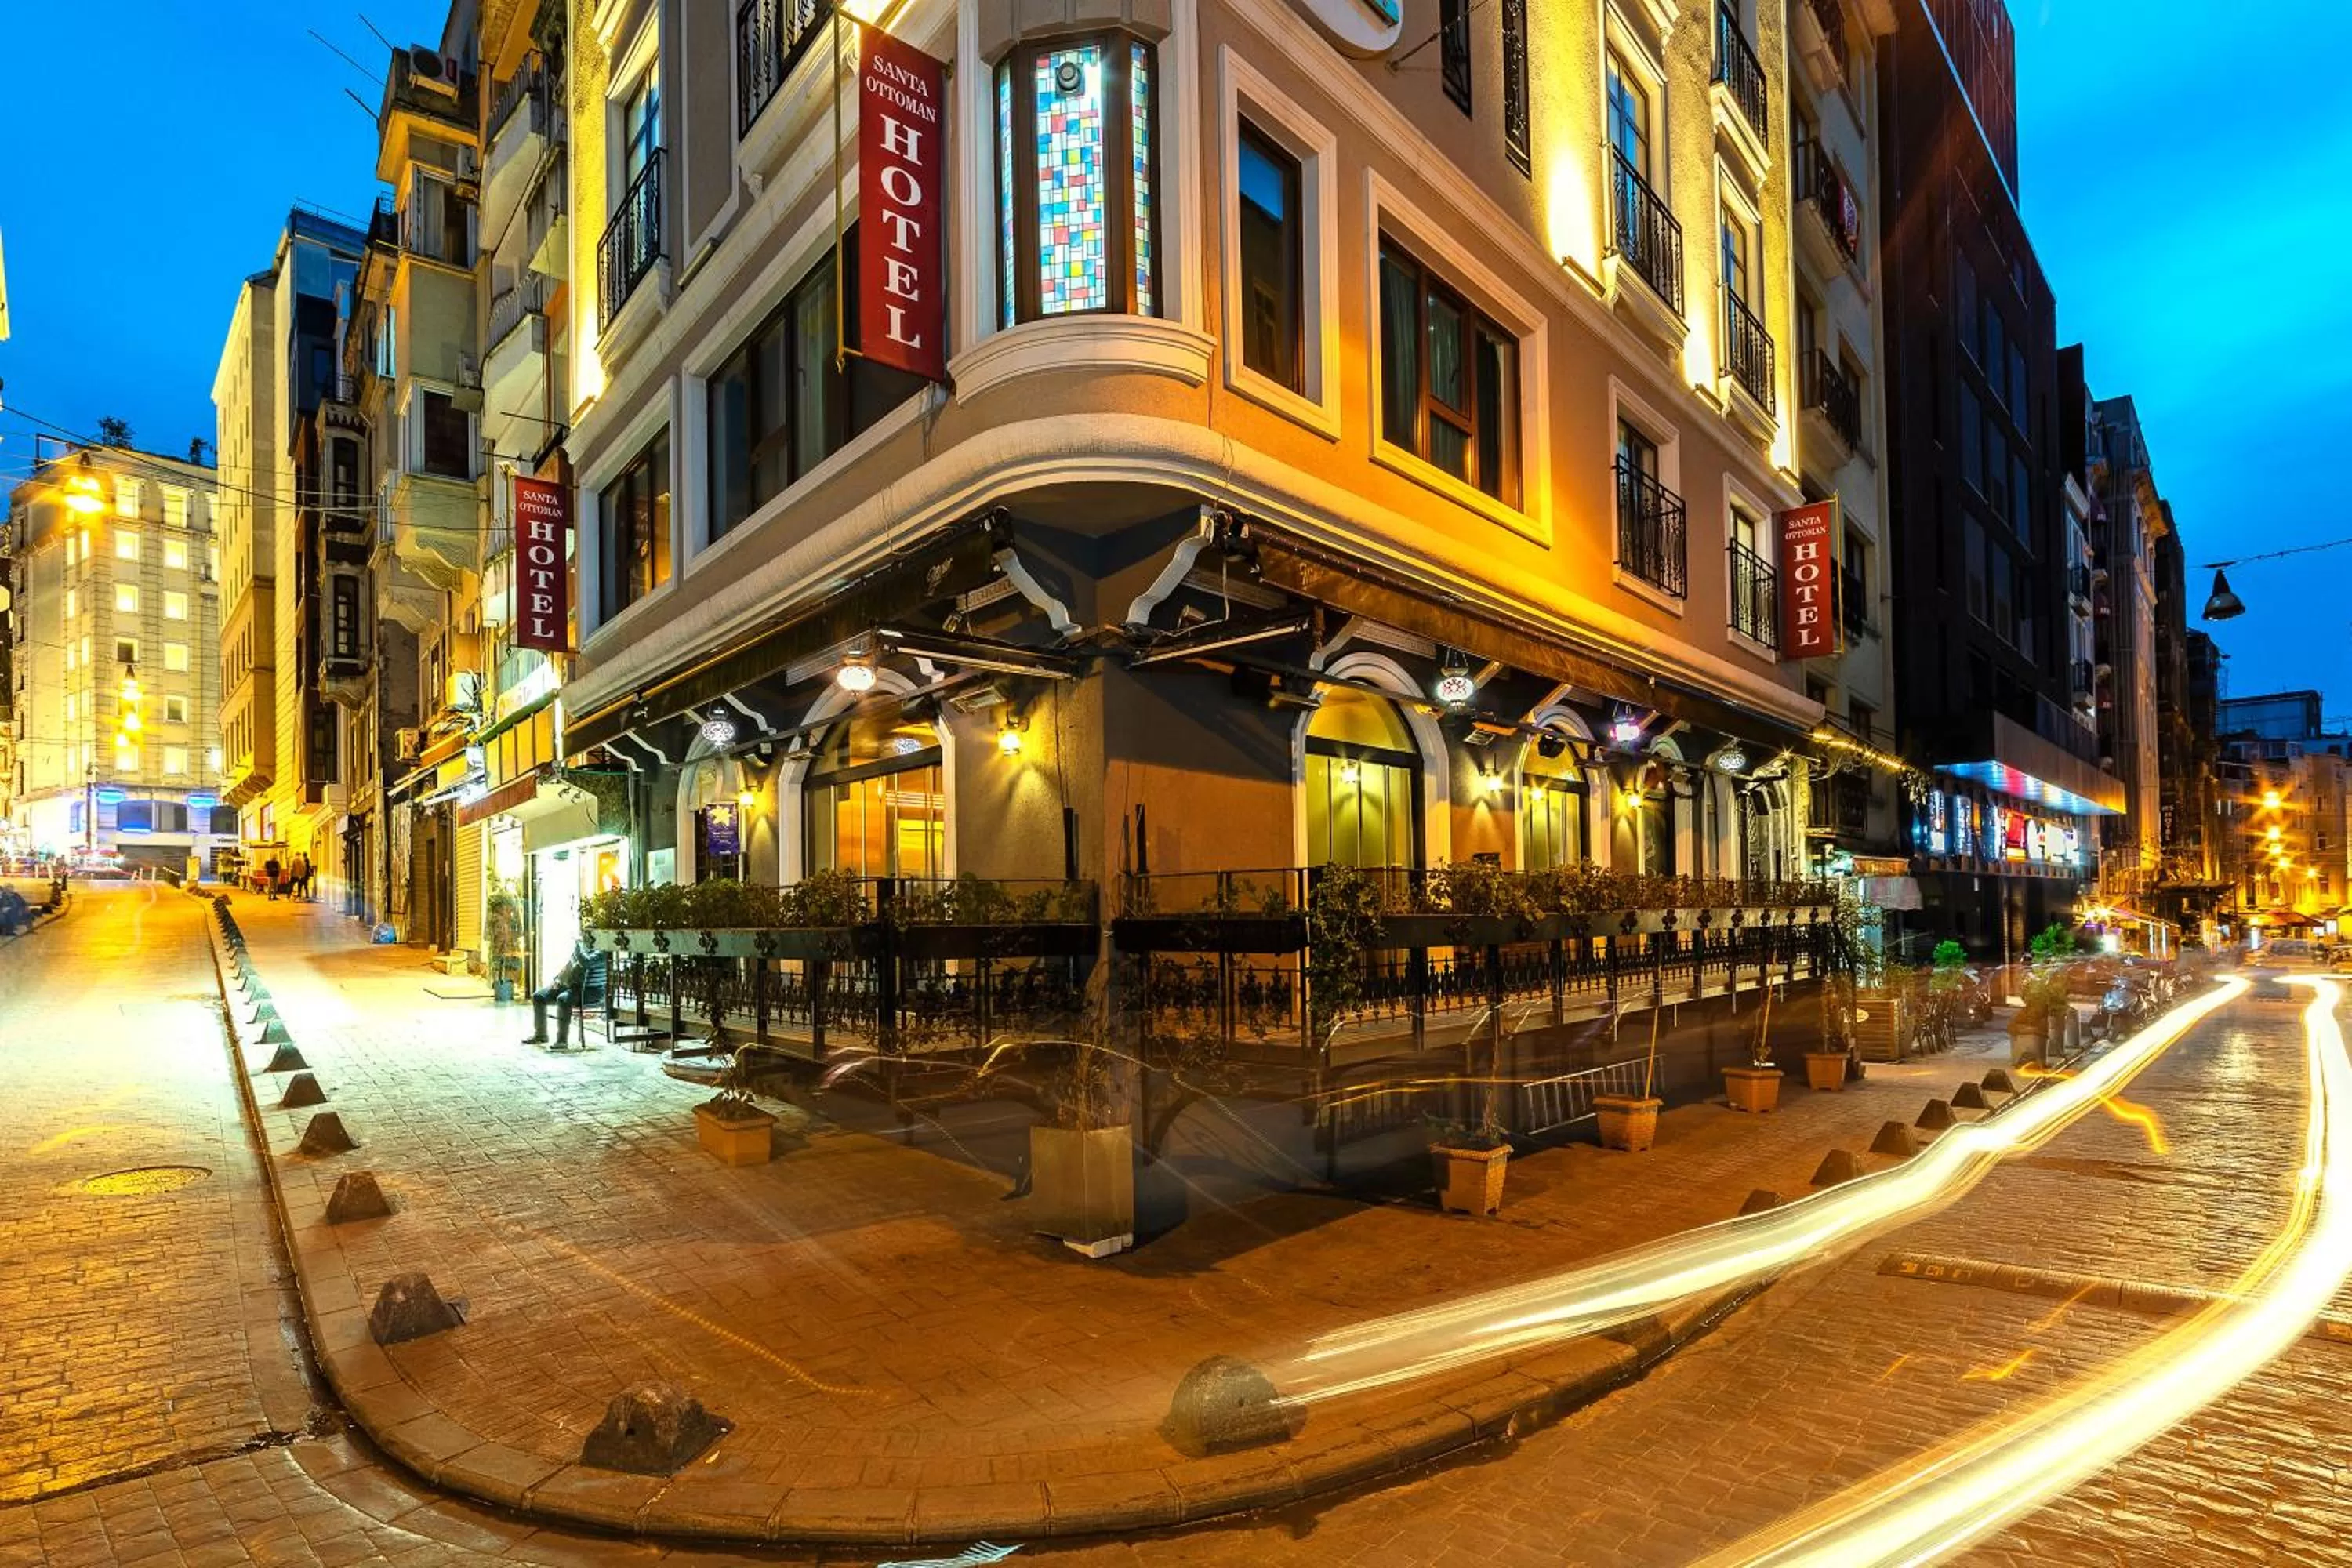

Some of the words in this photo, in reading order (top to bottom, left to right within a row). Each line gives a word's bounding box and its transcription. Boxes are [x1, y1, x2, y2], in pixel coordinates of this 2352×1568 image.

[873, 55, 928, 97] SANTA
[866, 76, 937, 122] OTTOMAN
[880, 113, 922, 348] HOTEL
[519, 502, 563, 517] OTTOMAN
[524, 490, 557, 505] SANTA
[1785, 526, 1826, 540] OTTOMAN
[1788, 516, 1822, 529] SANTA
[529, 521, 554, 637] HOTEL
[1795, 543, 1819, 646] HOTEL
